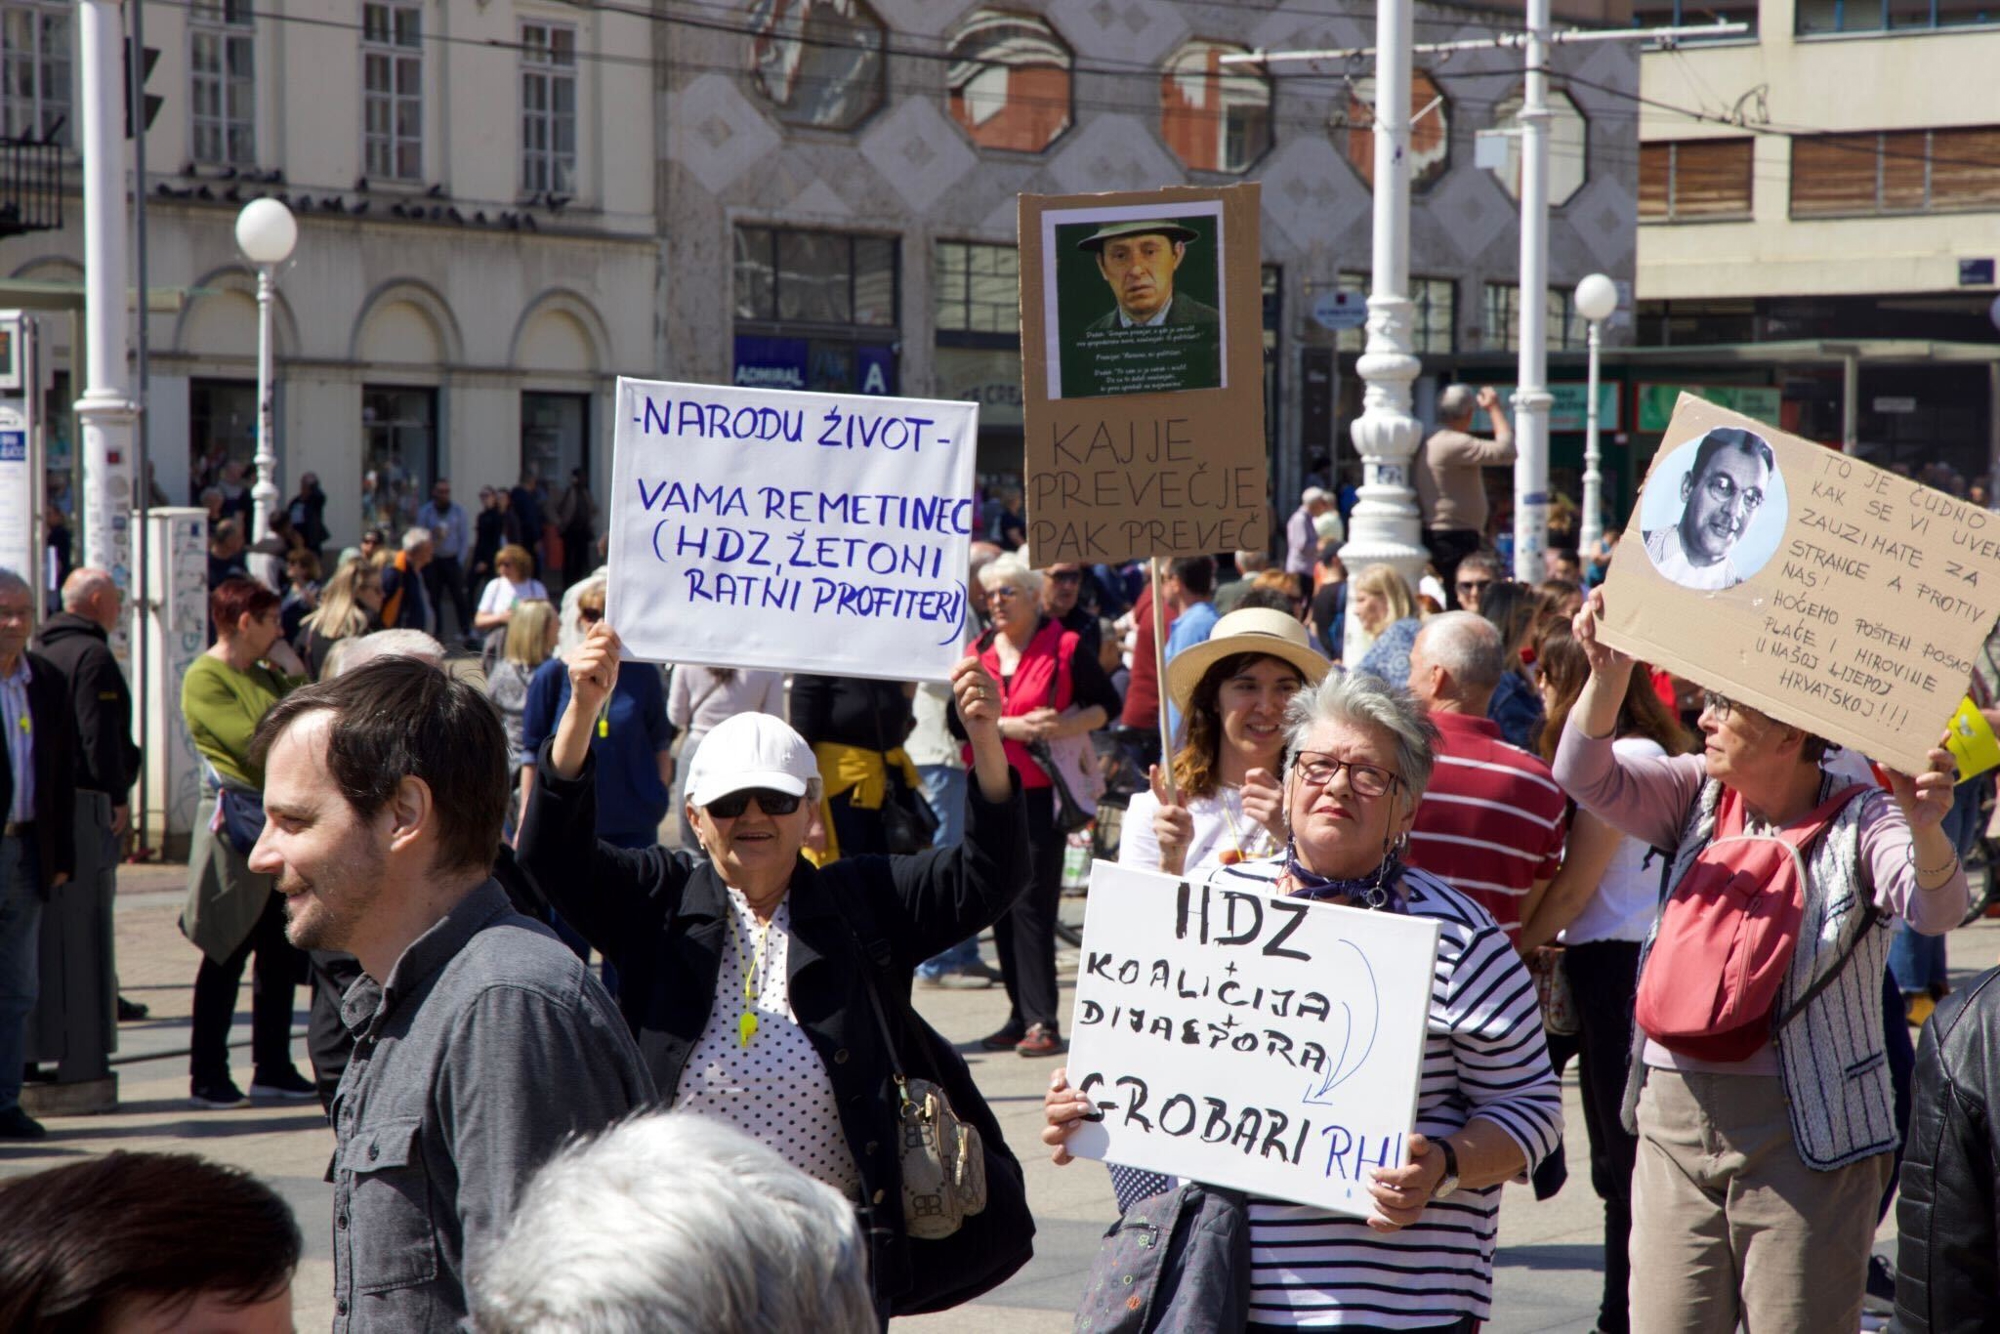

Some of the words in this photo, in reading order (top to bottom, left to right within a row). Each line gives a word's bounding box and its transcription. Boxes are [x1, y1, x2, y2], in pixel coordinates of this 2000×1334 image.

[735, 364, 805, 388] ADMIRAL
[863, 361, 887, 394] A
[637, 478, 749, 516] VAMA
[757, 487, 973, 535] REMETINEC
[1811, 481, 1847, 506] KAK
[1865, 500, 1893, 522] SE
[1910, 514, 1930, 536] VI
[1823, 454, 1852, 479] TO
[1864, 470, 1894, 495] JE
[1909, 484, 1987, 529] ČUDNO
[786, 528, 942, 579] ŽETONI
[1031, 520, 1108, 562] PAK
[1119, 512, 1260, 555] PREVEČ
[1789, 540, 1870, 580] STRANCE
[1887, 576, 1902, 592] A
[1918, 583, 1987, 623] PROTIV
[1945, 560, 1979, 588] ZA
[684, 569, 801, 611] RATNI
[812, 577, 967, 646] PROFITERI)
[1773, 589, 1839, 626] HOĆEMO
[1855, 618, 1911, 651] POŠTEN
[1923, 642, 1972, 675] POSAO
[1756, 636, 1767, 652] U
[1770, 642, 1820, 670] NAŠOJ
[1828, 661, 1894, 696] LIJEPOJ
[1764, 616, 1816, 648] PLAĆE
[1829, 637, 1837, 653] I
[1854, 648, 1938, 693] MIROVINE
[1175, 882, 1312, 961] HDZ
[1087, 952, 1331, 1022] KOALICIJA
[1079, 1072, 1311, 1165] GROBARI
